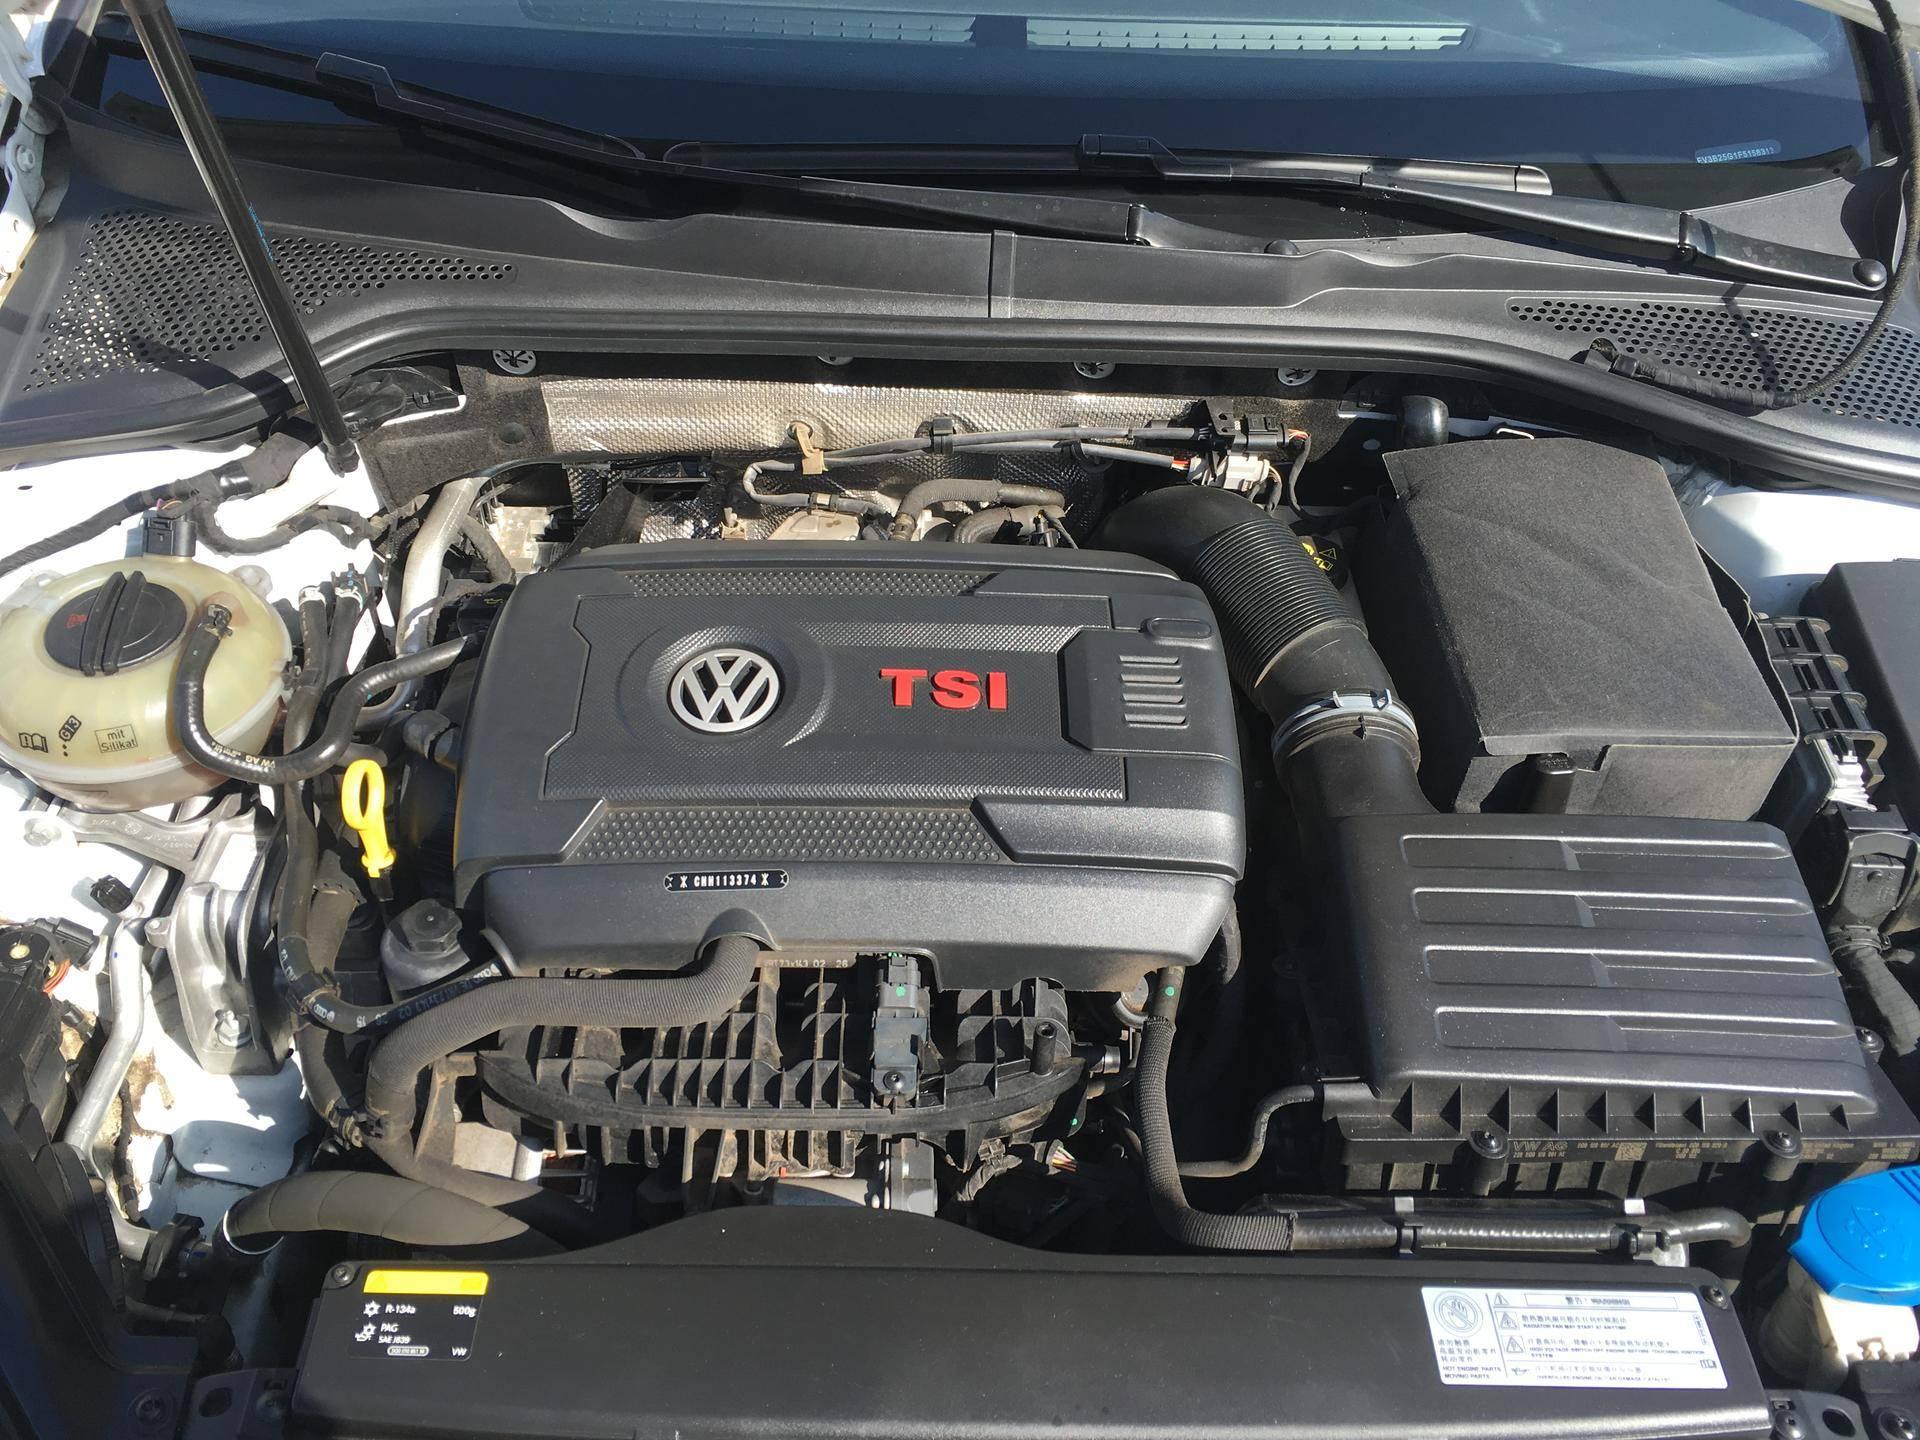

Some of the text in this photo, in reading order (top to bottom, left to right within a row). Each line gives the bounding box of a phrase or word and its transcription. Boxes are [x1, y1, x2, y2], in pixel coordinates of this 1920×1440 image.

[879, 667, 1008, 712] TSI
[60, 716, 80, 740] G13
[107, 728, 125, 741] mit
[100, 737, 136, 752] Silikat
[385, 1304, 416, 1315] R-134a
[380, 1323, 399, 1333] PAG
[378, 1335, 392, 1344] SAE
[451, 1347, 468, 1357] VW
